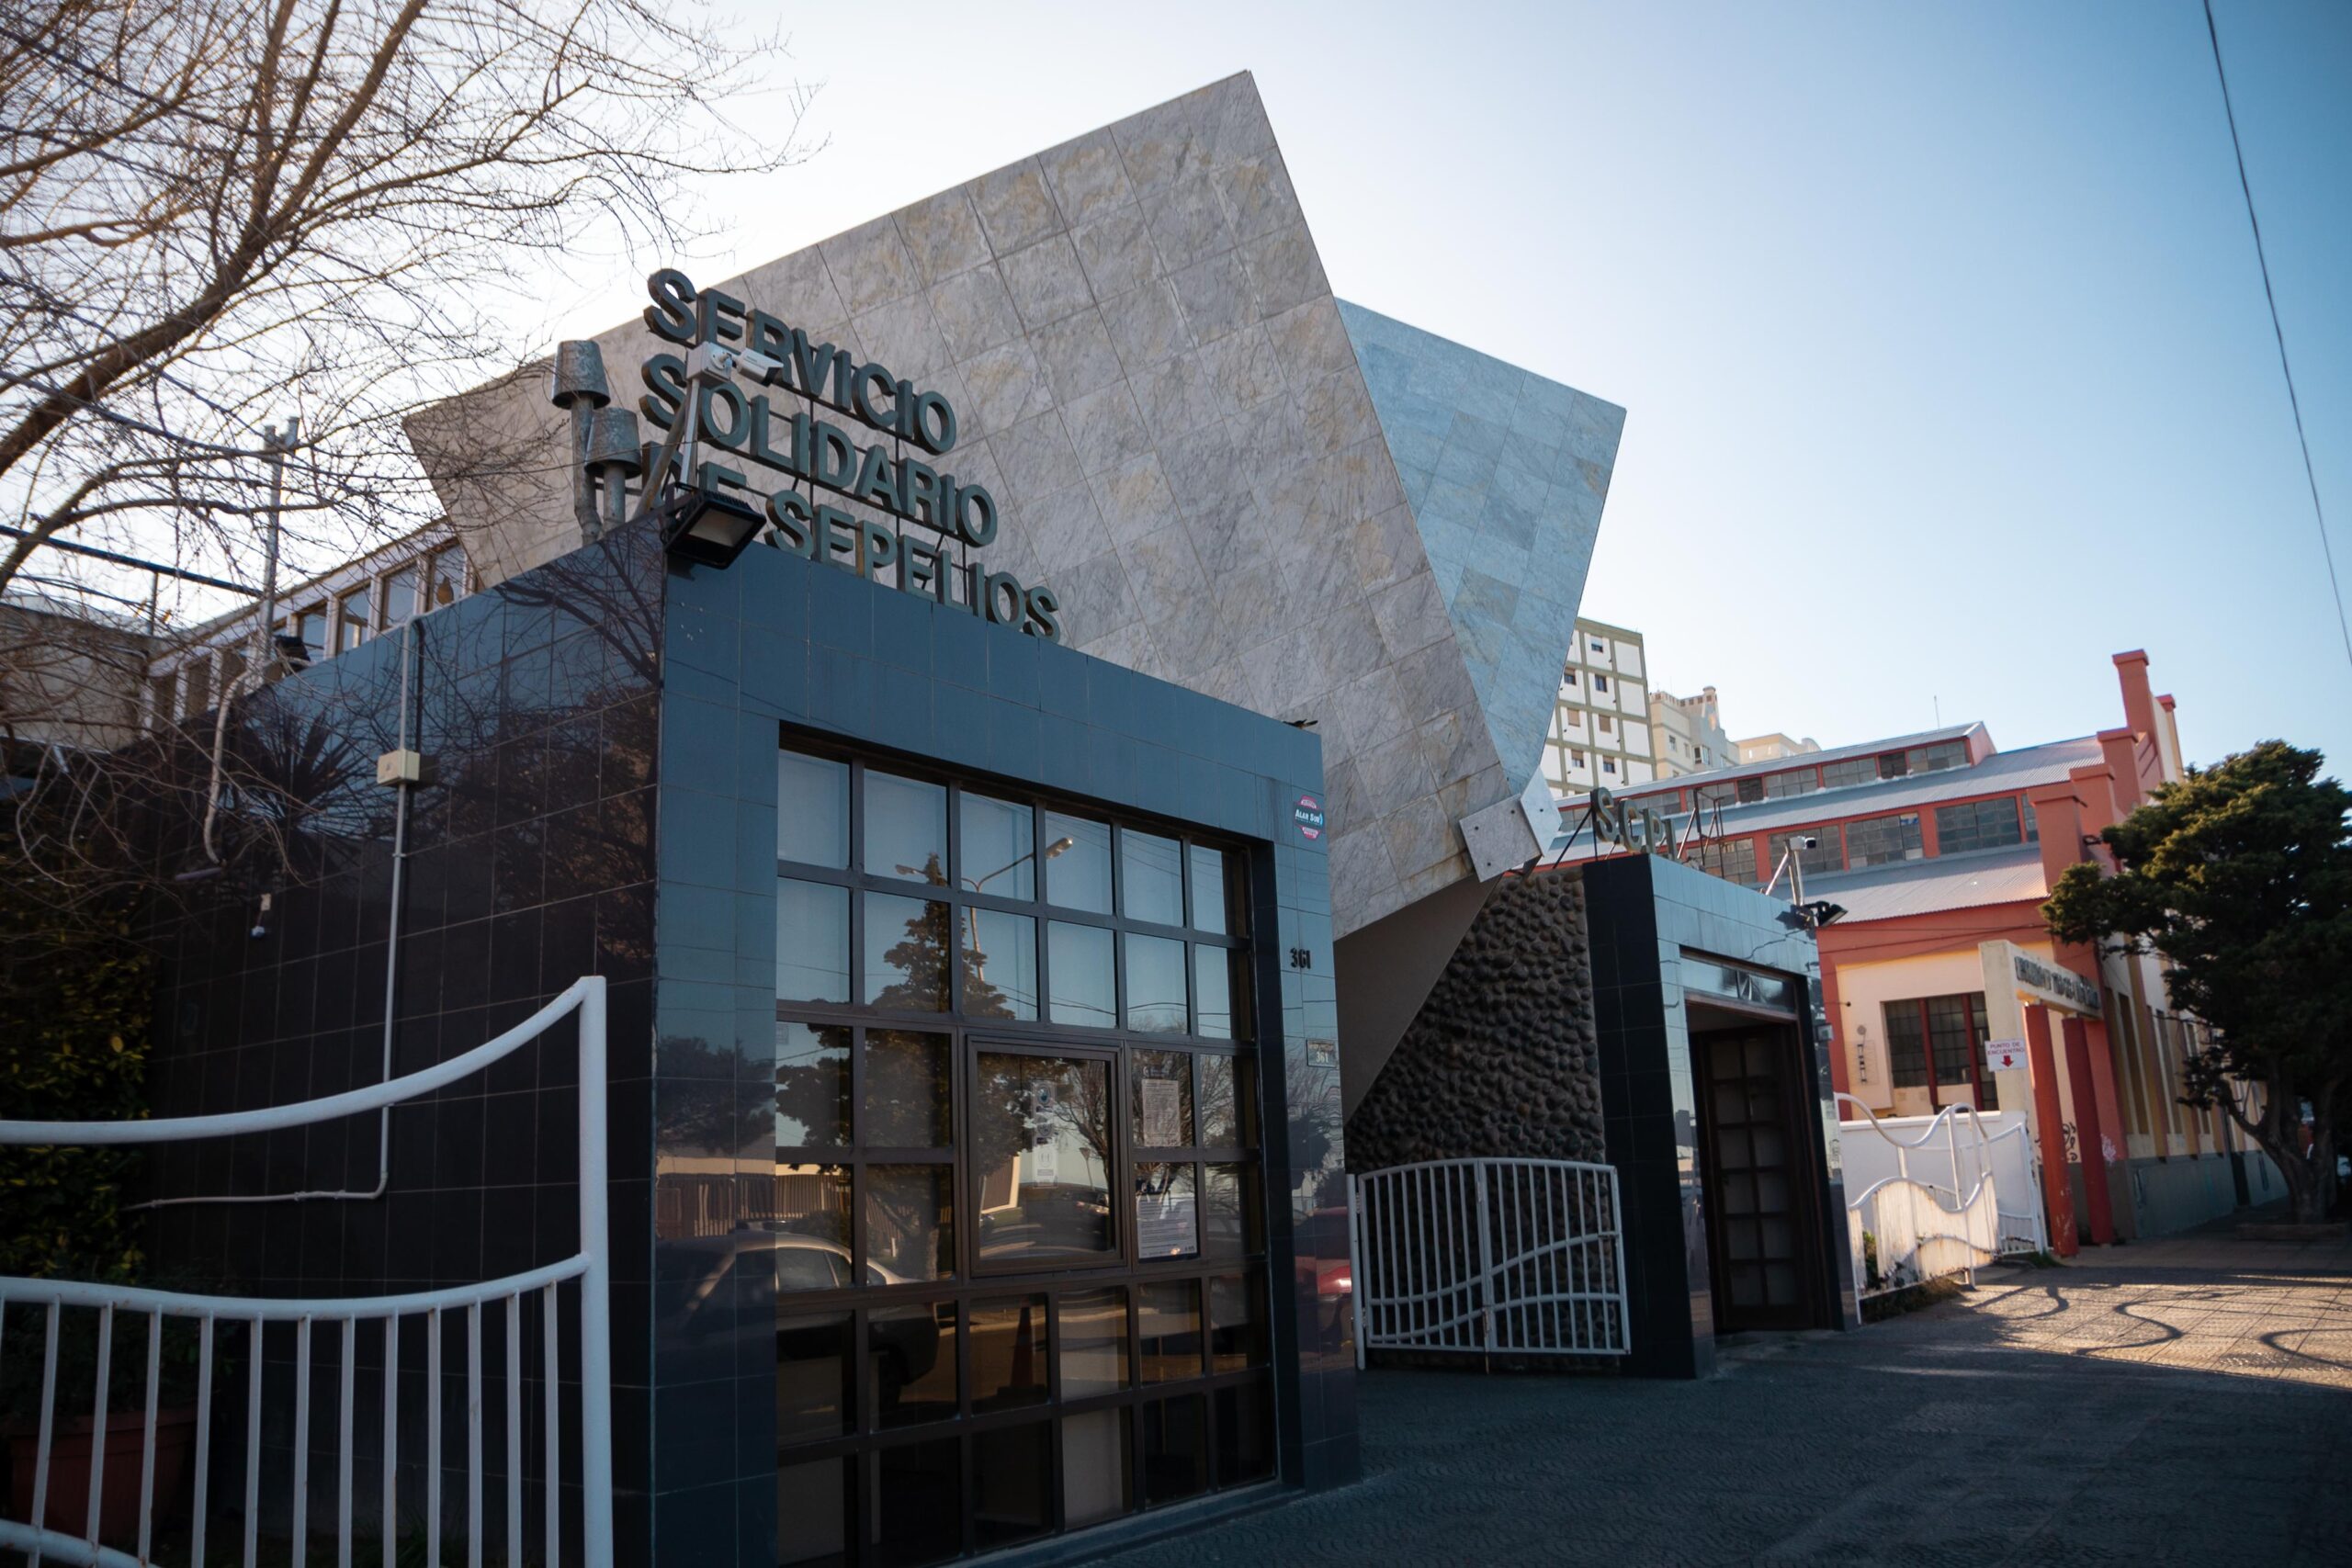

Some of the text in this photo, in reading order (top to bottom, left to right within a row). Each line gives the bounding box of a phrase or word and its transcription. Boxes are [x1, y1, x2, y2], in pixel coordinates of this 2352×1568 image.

[643, 268, 956, 455] SERVICIO
[639, 353, 998, 547] SOLIDARIO
[764, 490, 1059, 642] SEPELIOS
[1290, 947, 1311, 969] 361
[1316, 1051, 1329, 1063] 361
